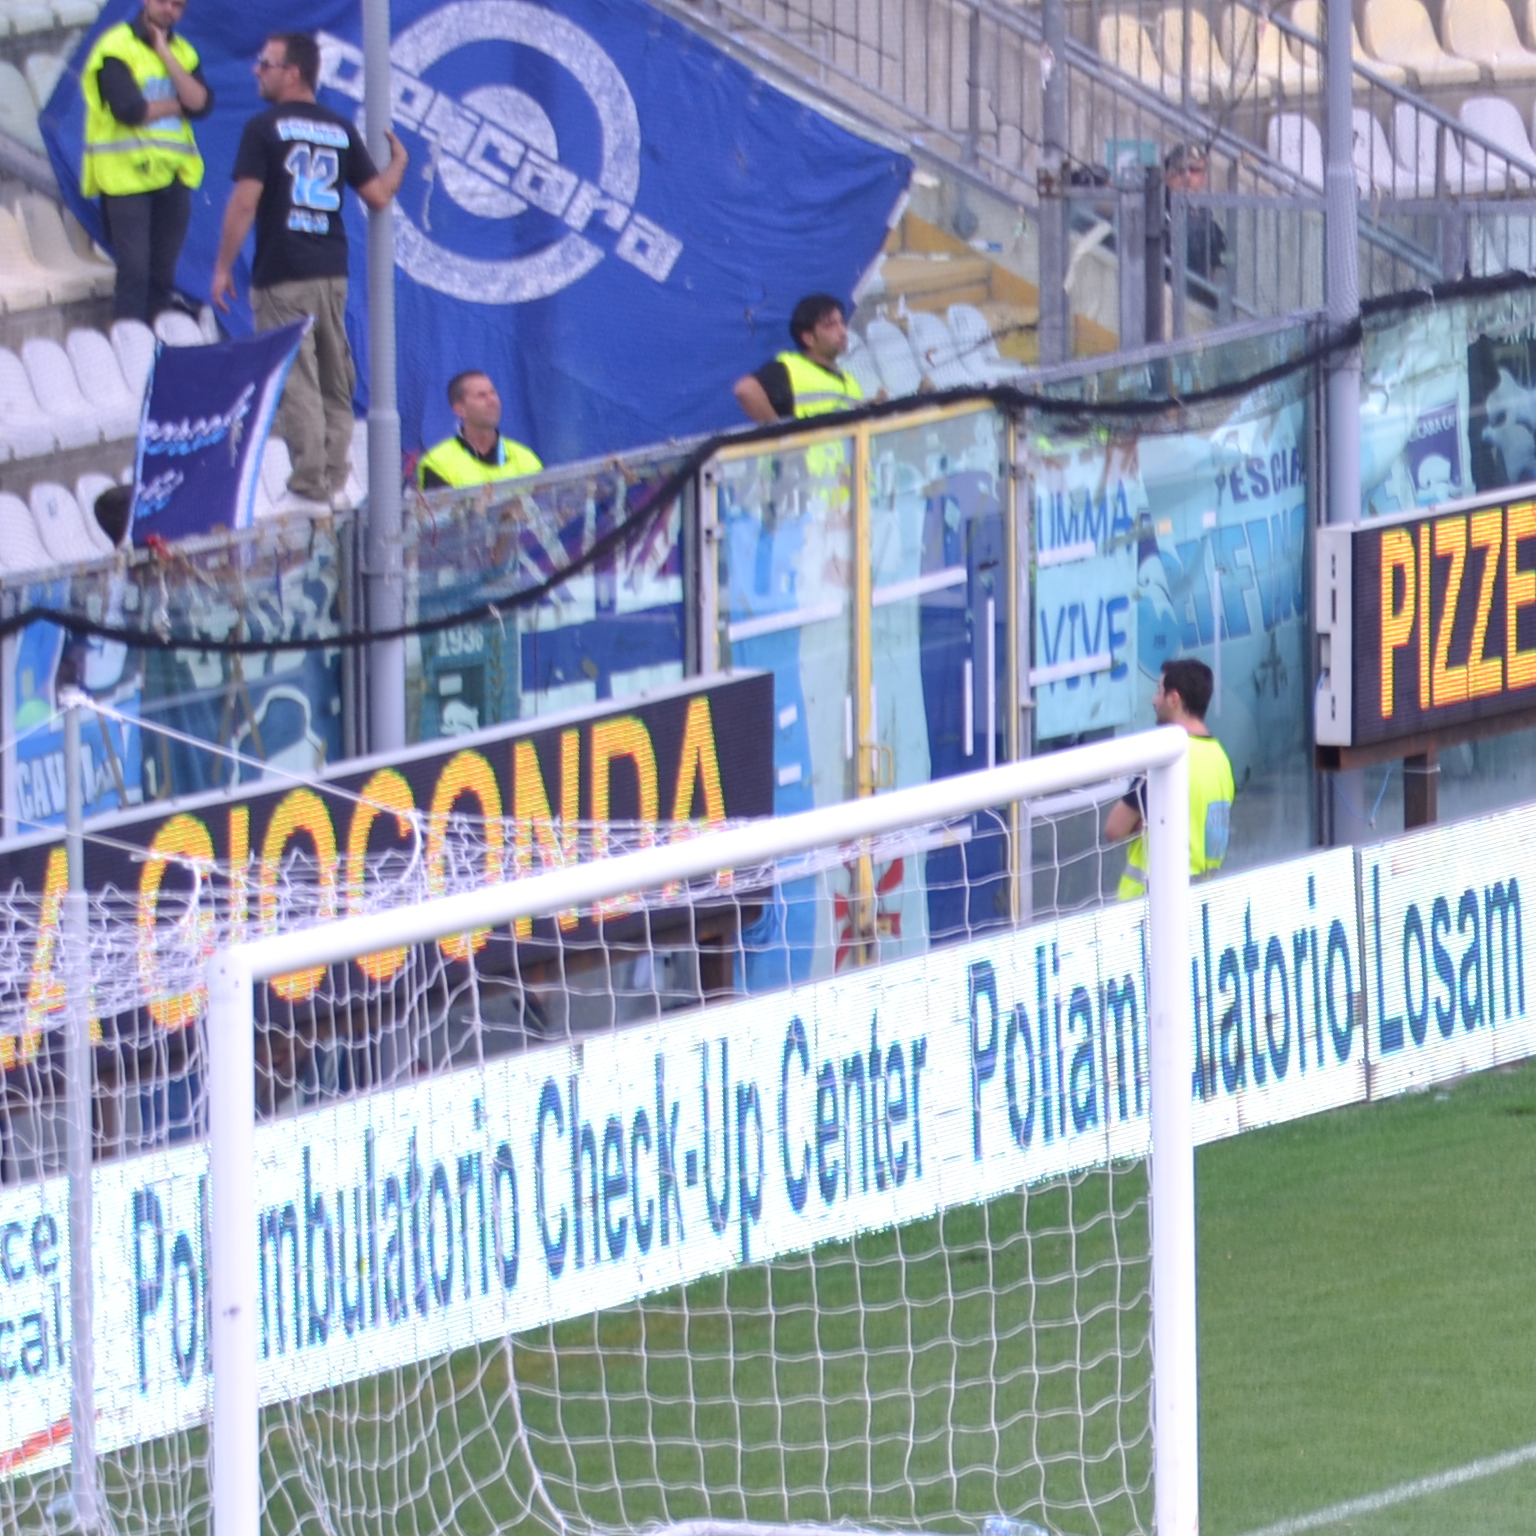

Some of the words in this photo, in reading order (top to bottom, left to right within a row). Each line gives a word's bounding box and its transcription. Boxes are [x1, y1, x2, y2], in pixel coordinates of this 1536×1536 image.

[285, 141, 341, 212] 12
[1039, 595, 1130, 697] VIVE
[138, 695, 734, 1031] GIOCONDA
[968, 875, 1358, 1162] Poliamlatorio
[1374, 862, 1527, 1055] Losam
[132, 1097, 520, 1396] Polmbulatorio
[536, 1036, 764, 1279] Check-Up
[782, 1005, 928, 1215] Center
